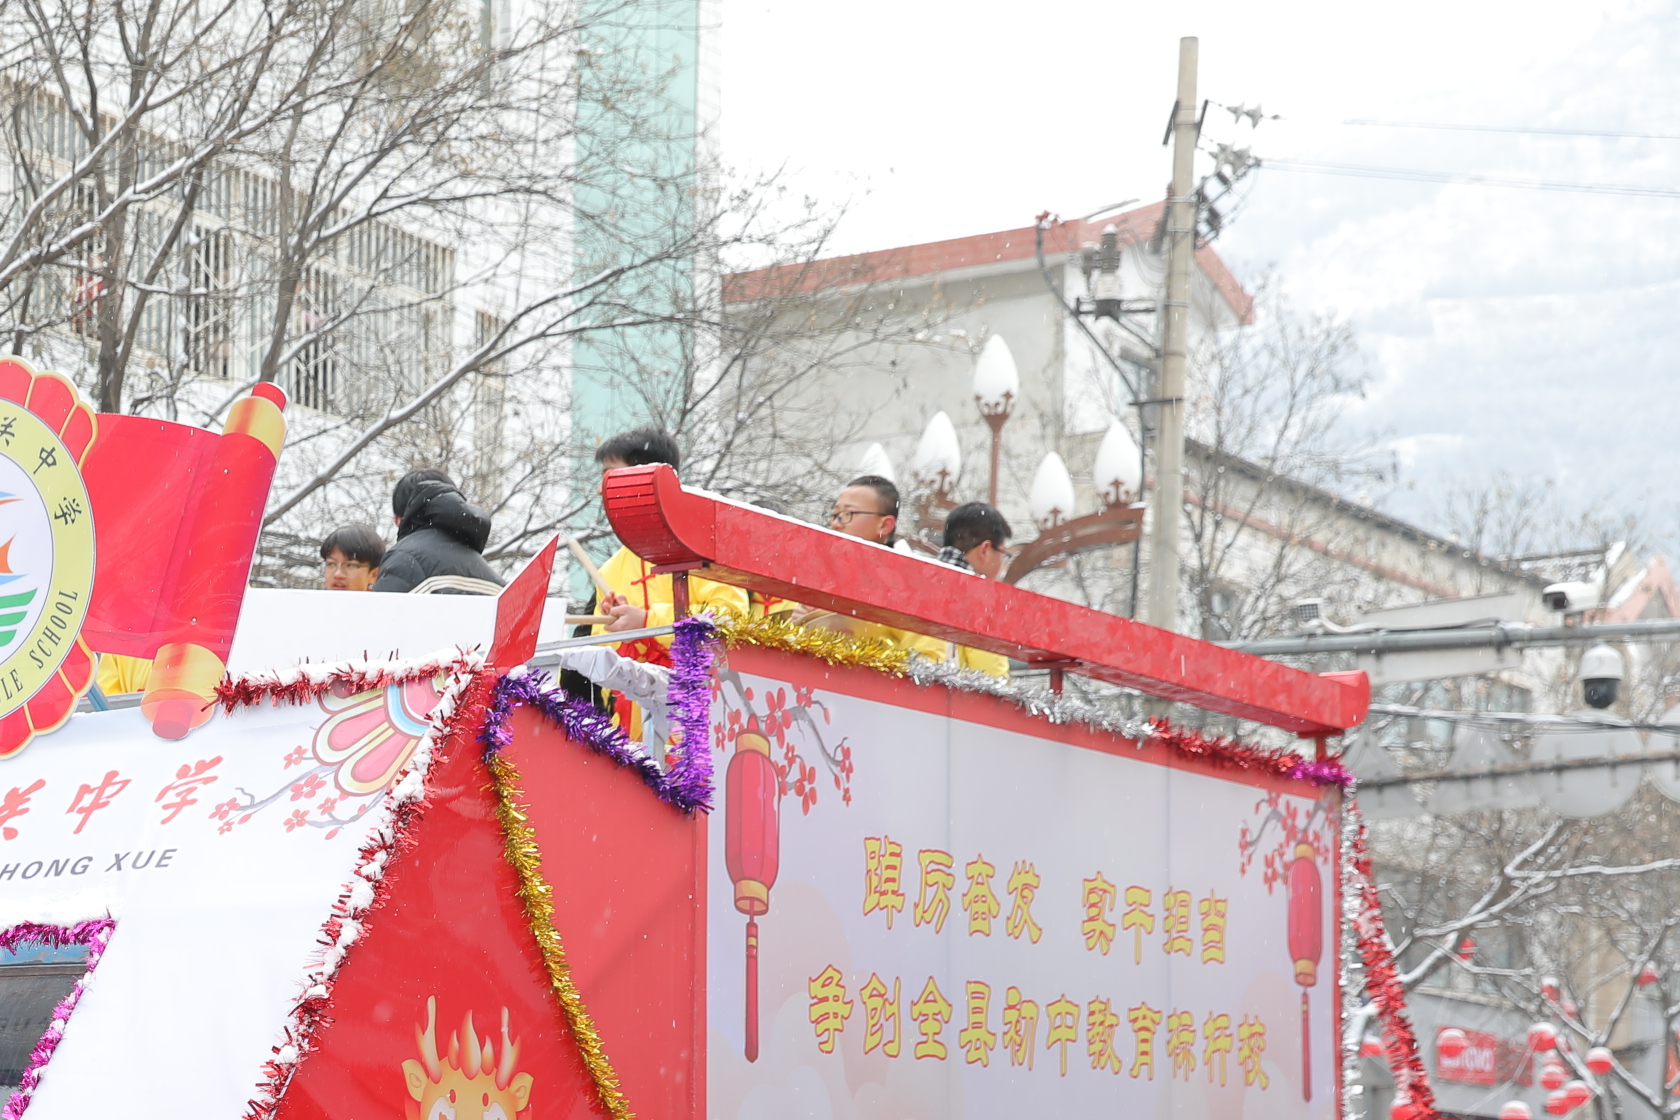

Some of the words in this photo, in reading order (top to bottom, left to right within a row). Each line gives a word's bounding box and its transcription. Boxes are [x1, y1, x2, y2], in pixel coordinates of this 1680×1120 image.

[28, 589, 79, 669] SCHOOL
[105, 848, 178, 873] XUE
[862, 835, 1044, 945] 踔厉奋发
[1081, 871, 1230, 966] 实干担当
[807, 963, 1271, 1092] 争创全县初中教育标杆校
